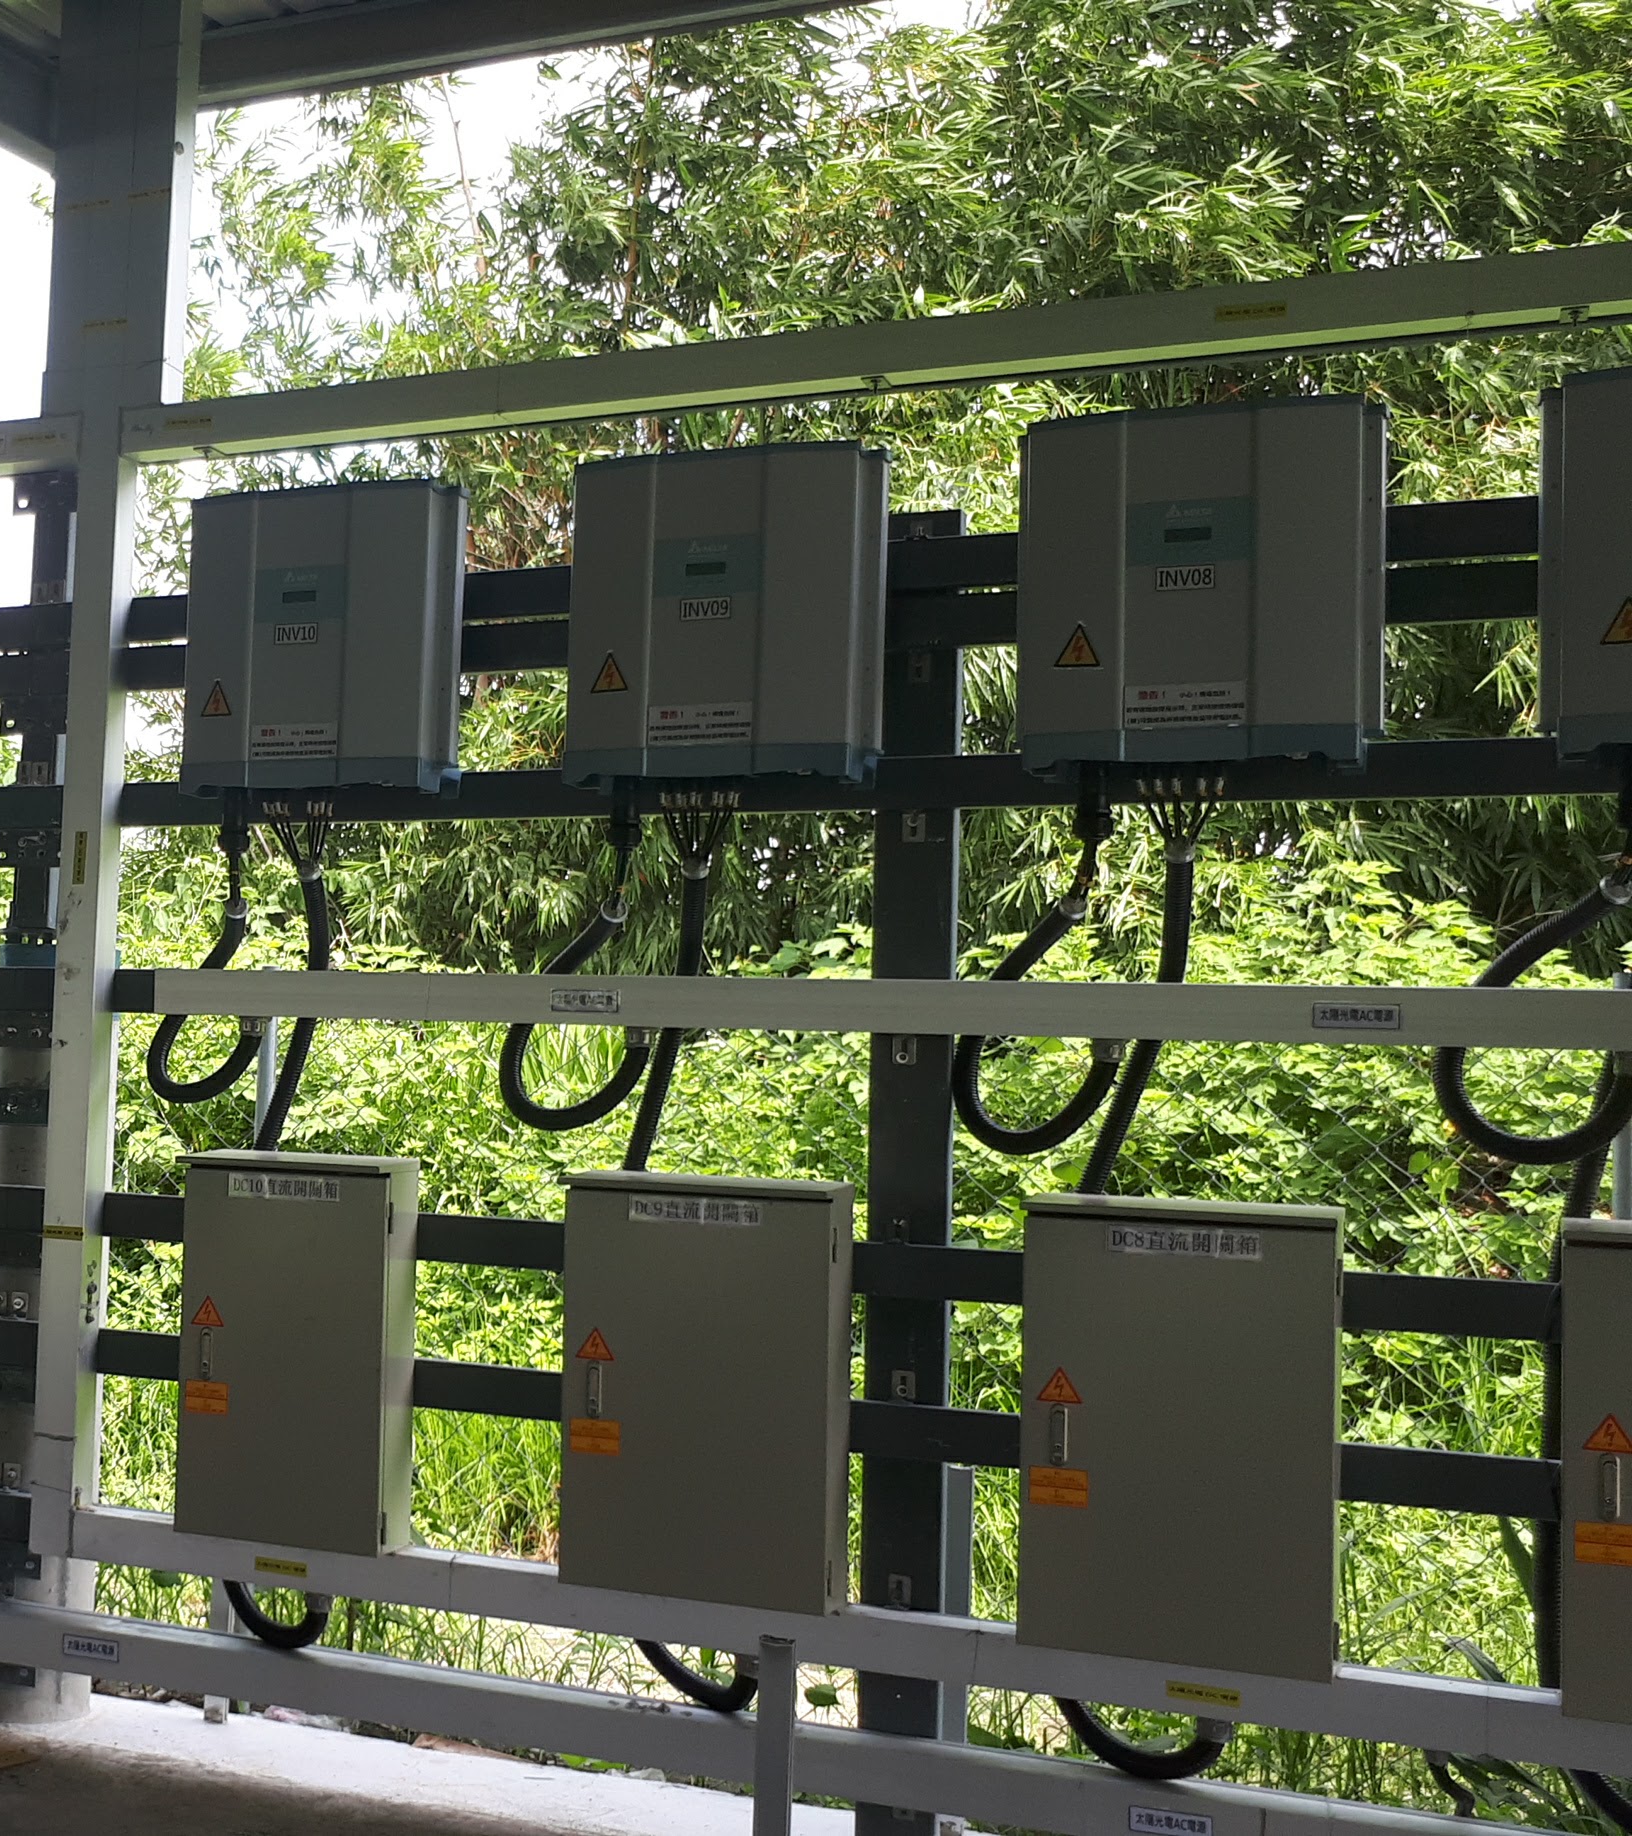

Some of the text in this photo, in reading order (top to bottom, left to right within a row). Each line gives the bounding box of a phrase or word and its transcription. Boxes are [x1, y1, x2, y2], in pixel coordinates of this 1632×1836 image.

[1159, 567, 1212, 587] INV08
[682, 599, 728, 617] INV09
[276, 626, 316, 641] INV10
[1320, 1008, 1393, 1022] 太陽光電AC電源
